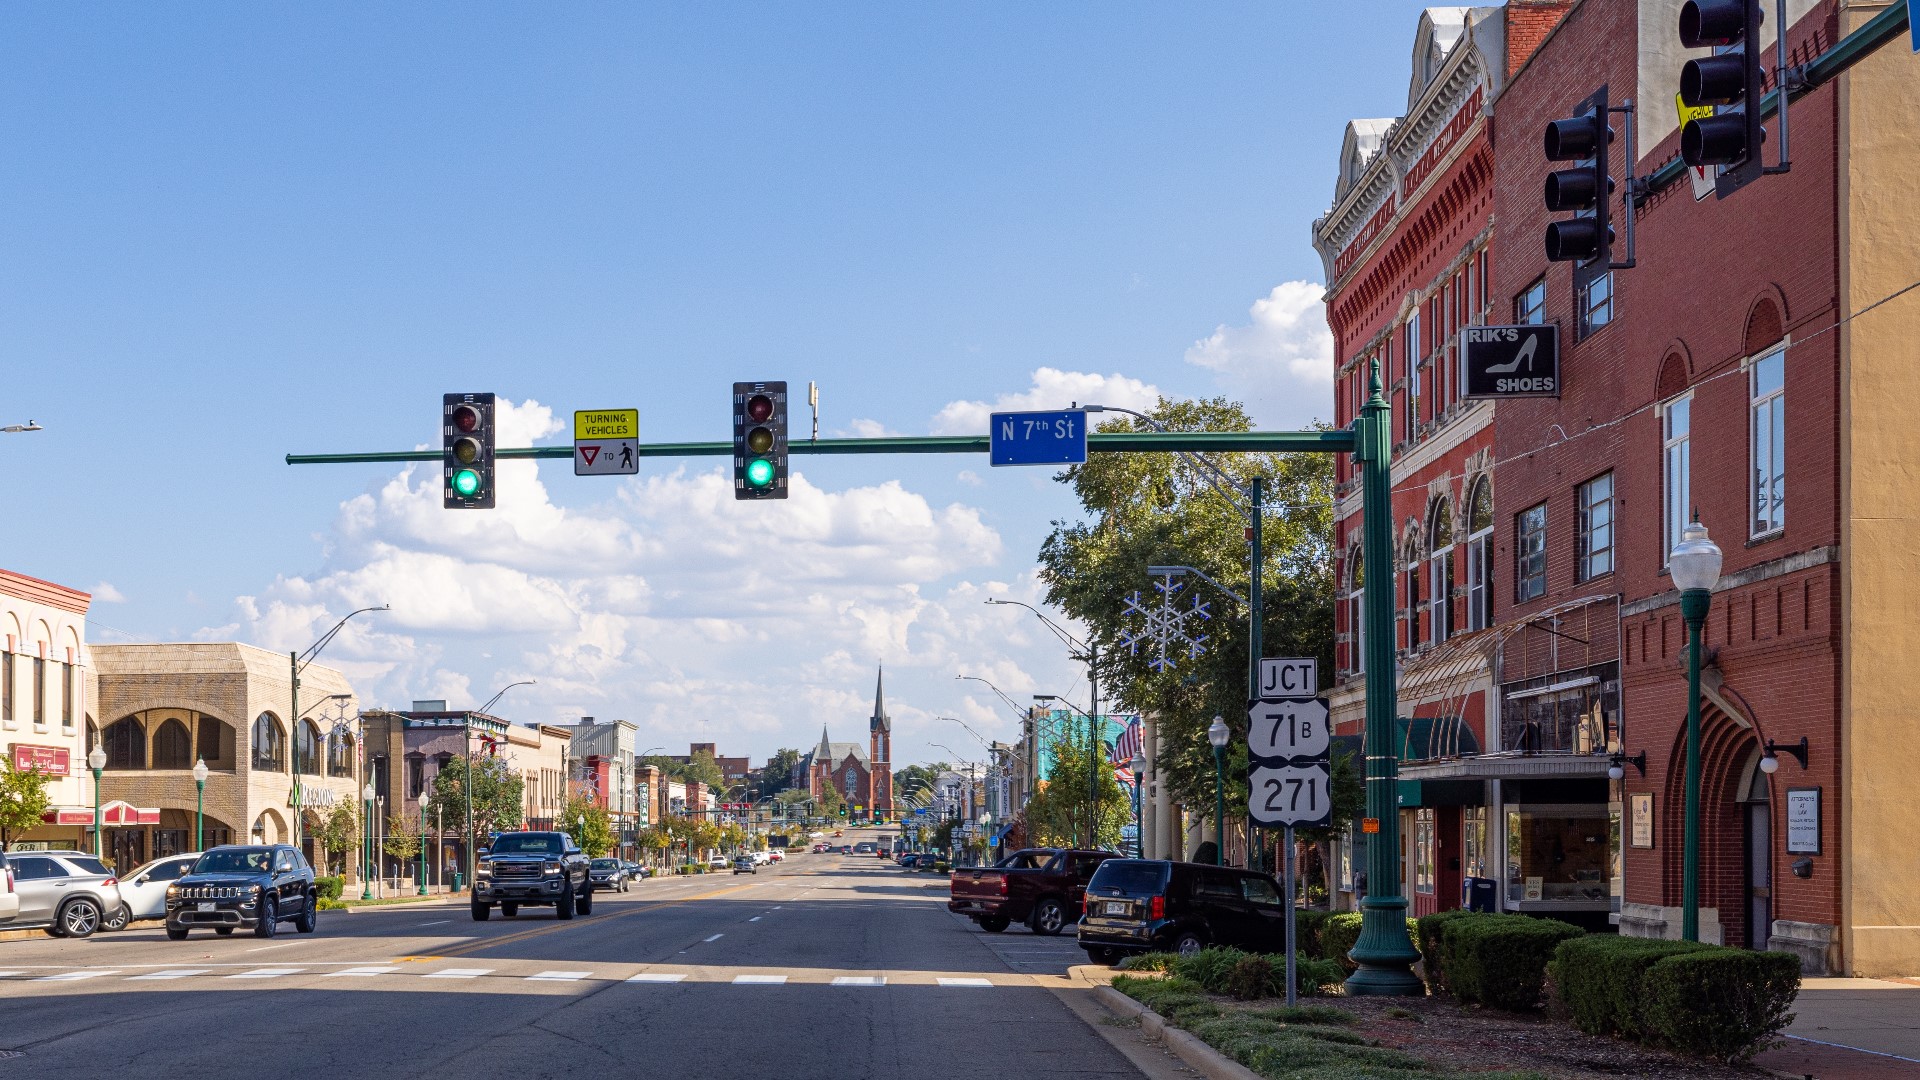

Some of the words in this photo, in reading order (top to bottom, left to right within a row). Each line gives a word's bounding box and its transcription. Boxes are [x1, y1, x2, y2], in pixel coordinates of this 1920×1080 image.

[1468, 328, 1519, 343] RIK'S
[1496, 377, 1554, 392] SHOES
[585, 414, 626, 423] TURNING
[585, 425, 628, 435] VEHICLES
[1002, 421, 1014, 441] N
[1023, 420, 1049, 440] 7th
[1054, 419, 1075, 439] St
[603, 452, 614, 461] TO
[1264, 664, 1312, 691] JCT
[1265, 713, 1295, 747] 71
[1301, 721, 1312, 738] B
[1263, 778, 1316, 812] 271
